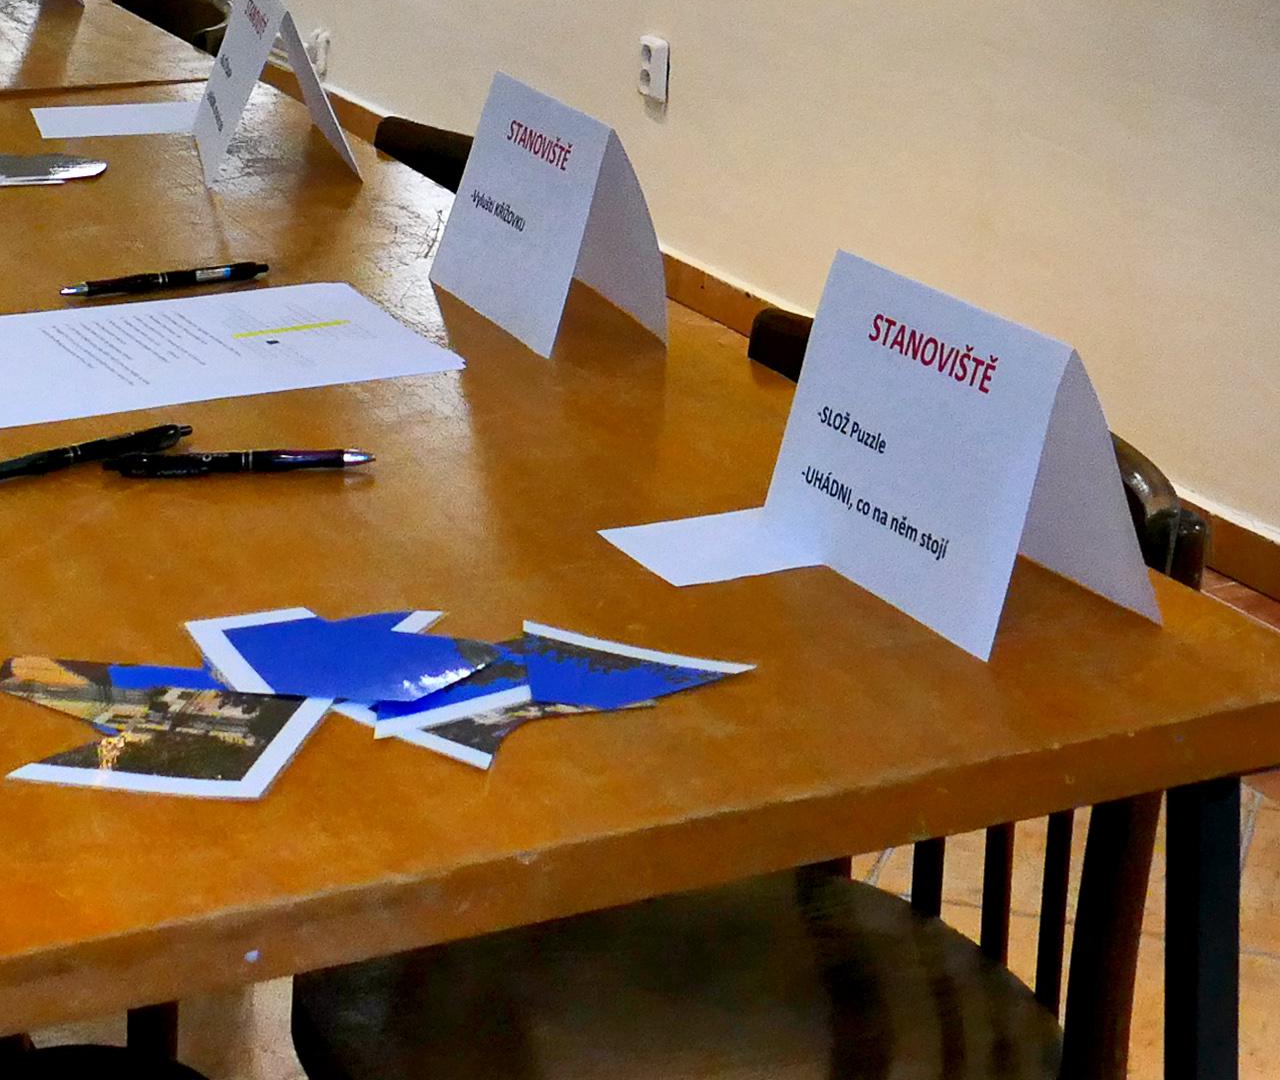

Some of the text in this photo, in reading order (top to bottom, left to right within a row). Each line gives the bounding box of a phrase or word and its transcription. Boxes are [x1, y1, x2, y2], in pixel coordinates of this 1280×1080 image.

[505, 119, 574, 172] STANOVIŠTĚ
[867, 312, 1000, 395] STANOVIŠTĚ
[816, 405, 888, 455] -SLOŽ Puzzle
[800, 463, 950, 561] -UHÁDNI, co na něm stojí
